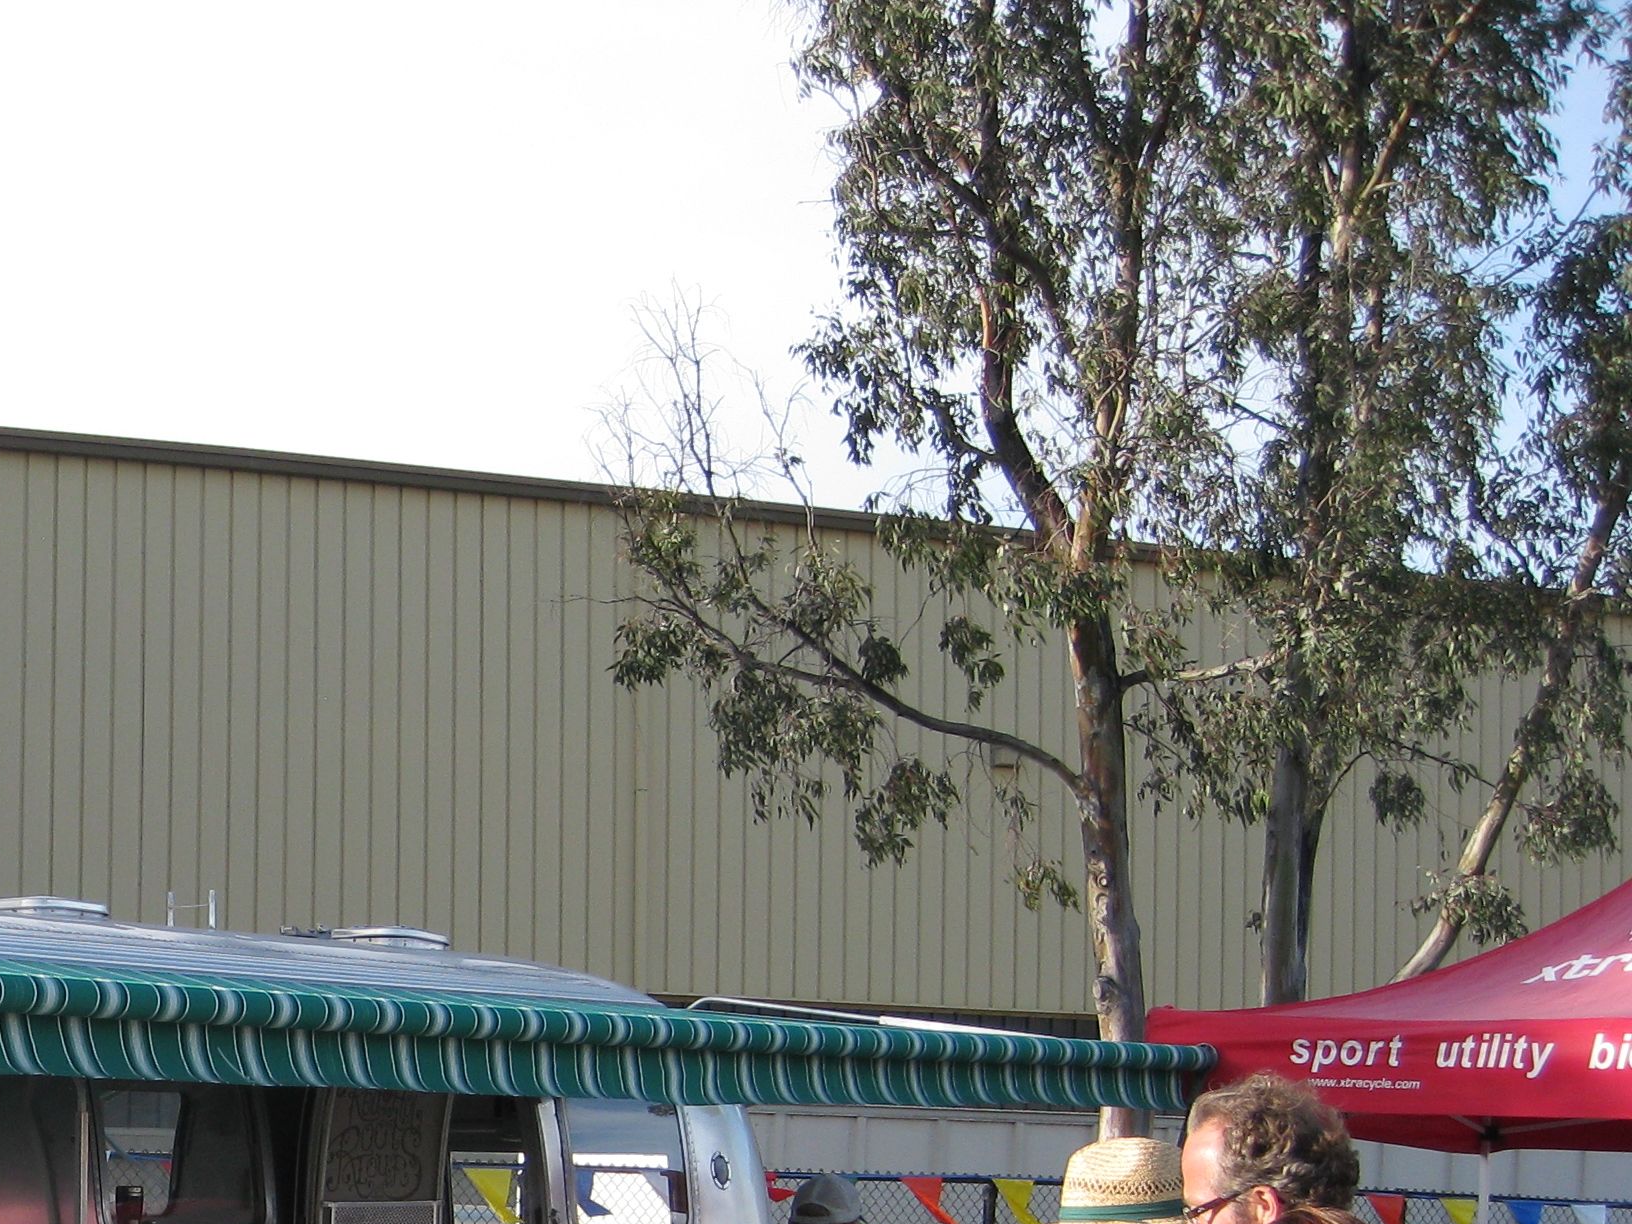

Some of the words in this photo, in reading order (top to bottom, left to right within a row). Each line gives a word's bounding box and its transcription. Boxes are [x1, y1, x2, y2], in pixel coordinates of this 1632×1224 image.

[1520, 952, 1632, 985] xtr
[1290, 1034, 1402, 1073] sport
[1436, 1033, 1555, 1079] utility
[1588, 1033, 1632, 1070] bi
